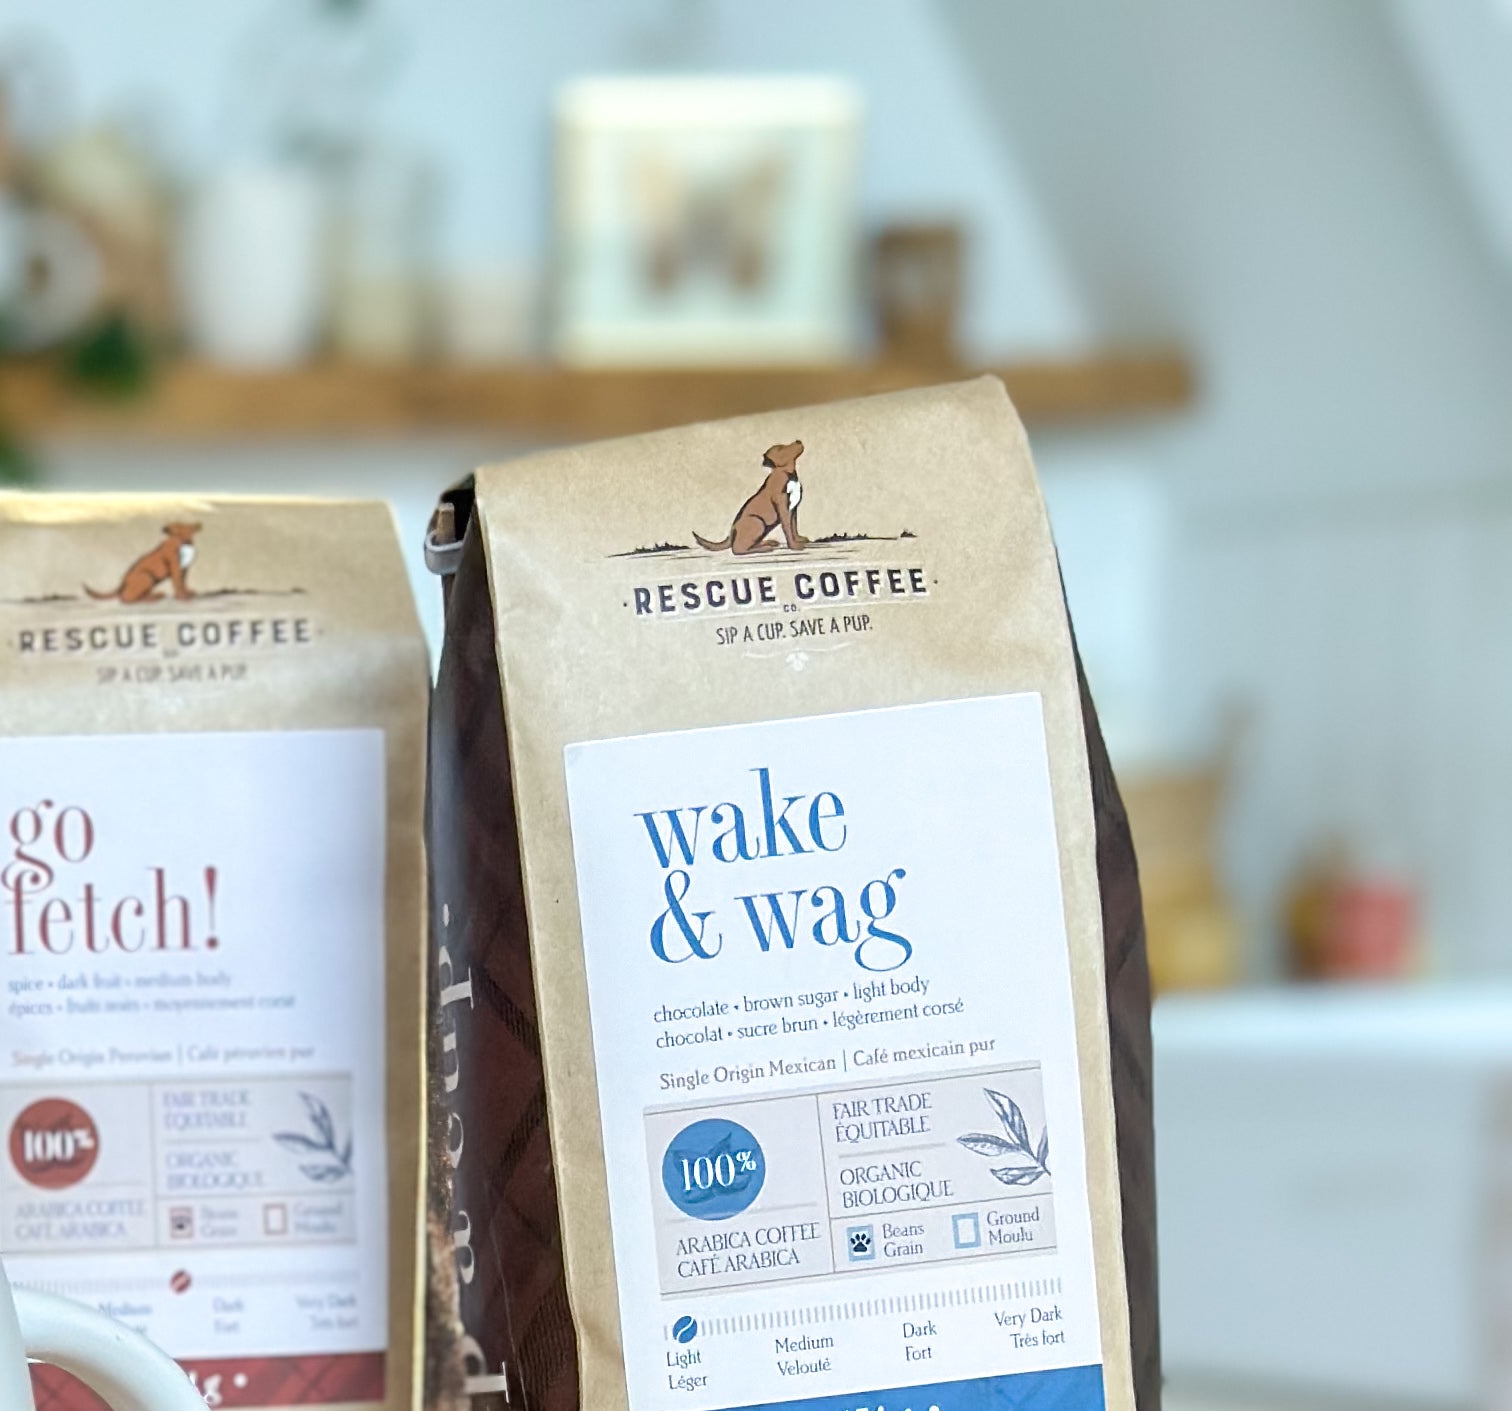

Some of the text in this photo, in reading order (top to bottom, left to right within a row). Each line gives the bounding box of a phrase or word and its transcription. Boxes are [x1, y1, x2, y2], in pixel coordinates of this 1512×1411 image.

[633, 568, 927, 616] RESCUE COFFEE
[19, 618, 310, 653] RESCUE COFFEE
[716, 614, 873, 645] SIP A CUP. SAVE A PUP.
[633, 768, 848, 870] wake
[0, 800, 95, 894] go
[4, 866, 220, 957] fetch!
[649, 868, 913, 972] & wag
[653, 975, 930, 1023] chocolate brown sugar light body
[656, 997, 965, 1048] chocolat sucre brun légèrement corsé
[660, 1039, 996, 1091] Single Origin Mexican Café mexicain pur
[833, 1092, 932, 1120] FAIR TRADE
[836, 1115, 931, 1143] ÉQUITABLE
[681, 1150, 757, 1191] 100%
[840, 1160, 922, 1185] ORGANIC
[843, 1180, 954, 1209] BIOLOGIQUE
[987, 1206, 1039, 1226] Ground
[676, 1222, 821, 1256] ARABICA COFFEE
[882, 1223, 925, 1239] Beans
[988, 1227, 1033, 1246] Moulu
[678, 1248, 800, 1278] CAFÉ ARABICA
[883, 1241, 923, 1257] Grain
[903, 1320, 937, 1338] Dark
[994, 1305, 1063, 1328] Very Dark
[775, 1335, 834, 1353] Medium
[1010, 1330, 1066, 1348] Très fort
[666, 1349, 702, 1369] Light
[777, 1357, 832, 1376] Velouté
[905, 1346, 932, 1361] Fort
[668, 1374, 708, 1391] Léger
